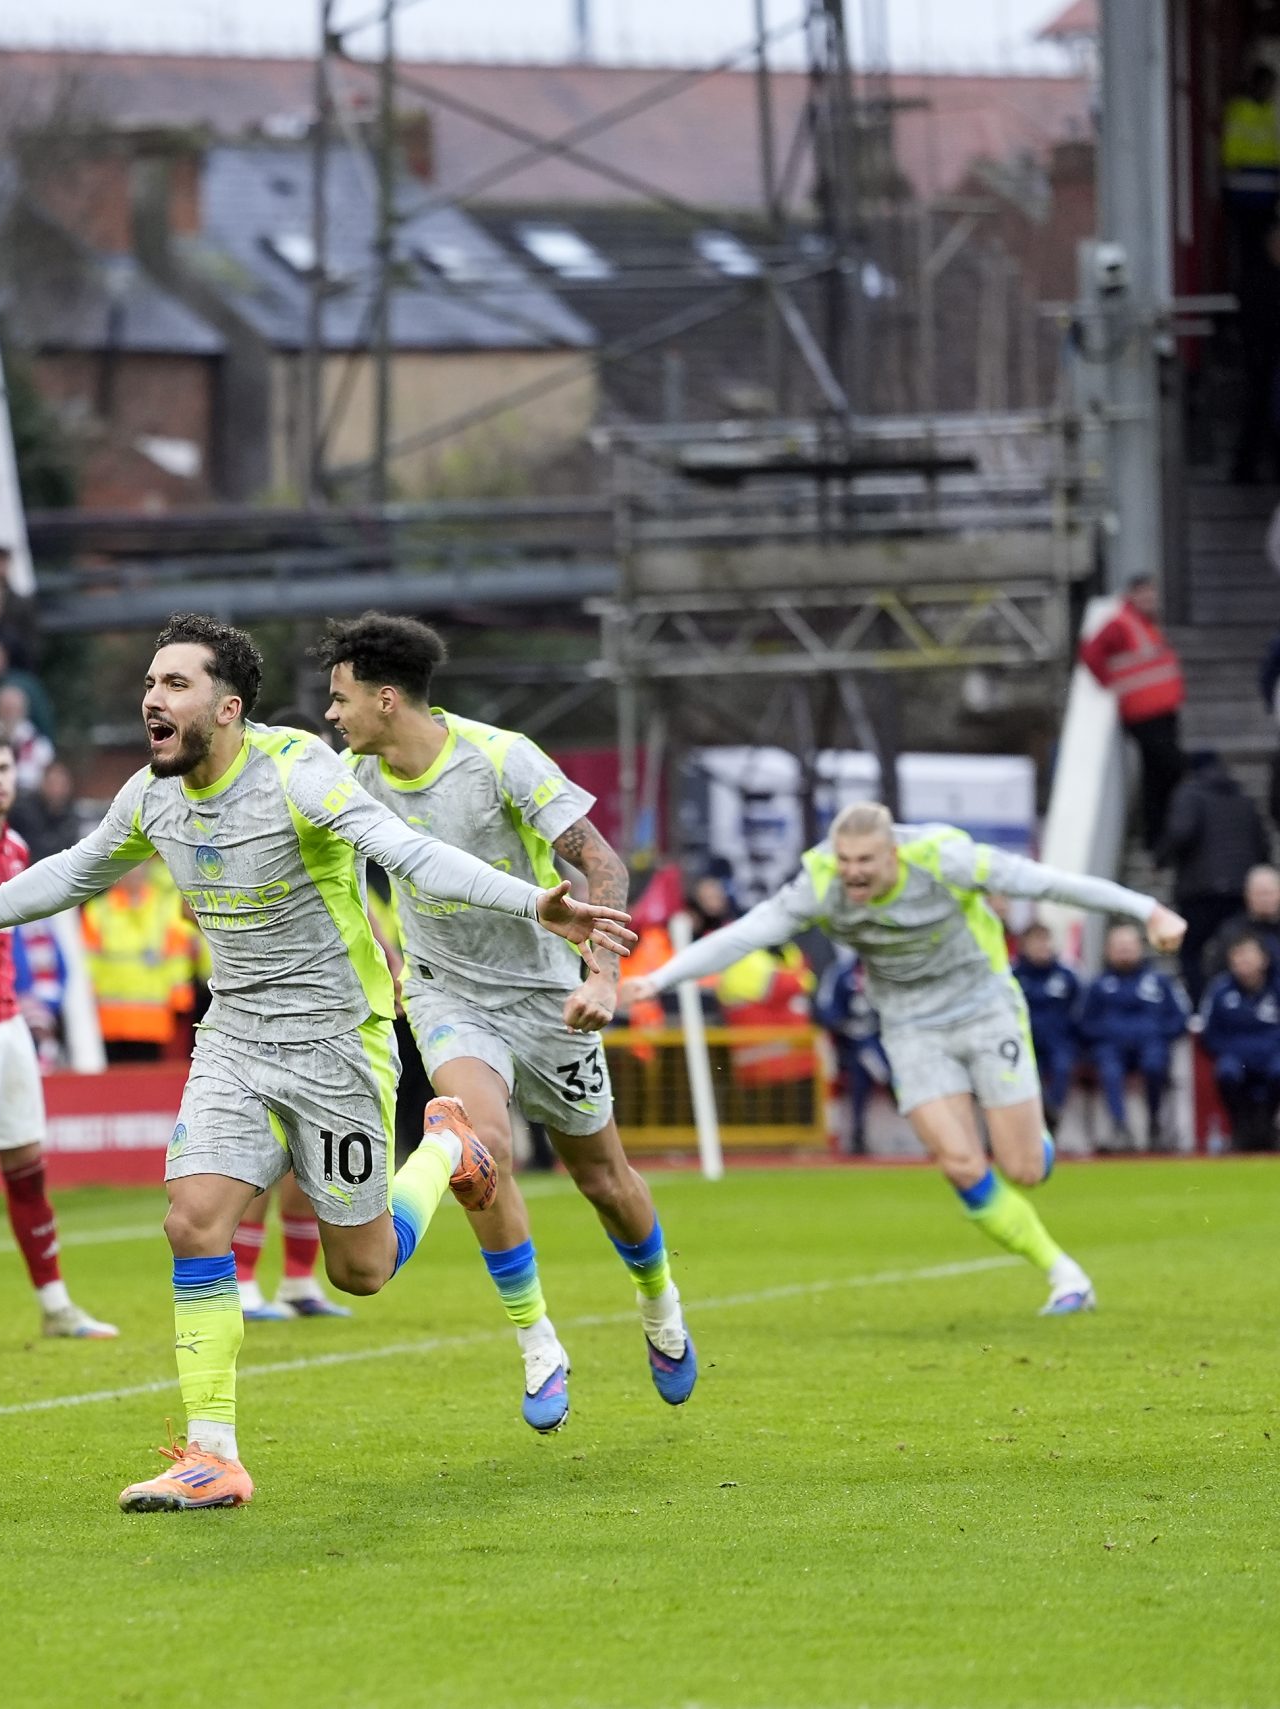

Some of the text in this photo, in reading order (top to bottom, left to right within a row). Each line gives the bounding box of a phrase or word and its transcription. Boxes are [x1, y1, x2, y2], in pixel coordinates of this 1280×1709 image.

[182, 881, 290, 912] TIHAD
[416, 901, 472, 915] AIRWA
[999, 1039, 1019, 1068] 9
[557, 1047, 603, 1102] 33
[320, 1130, 373, 1185] 10
